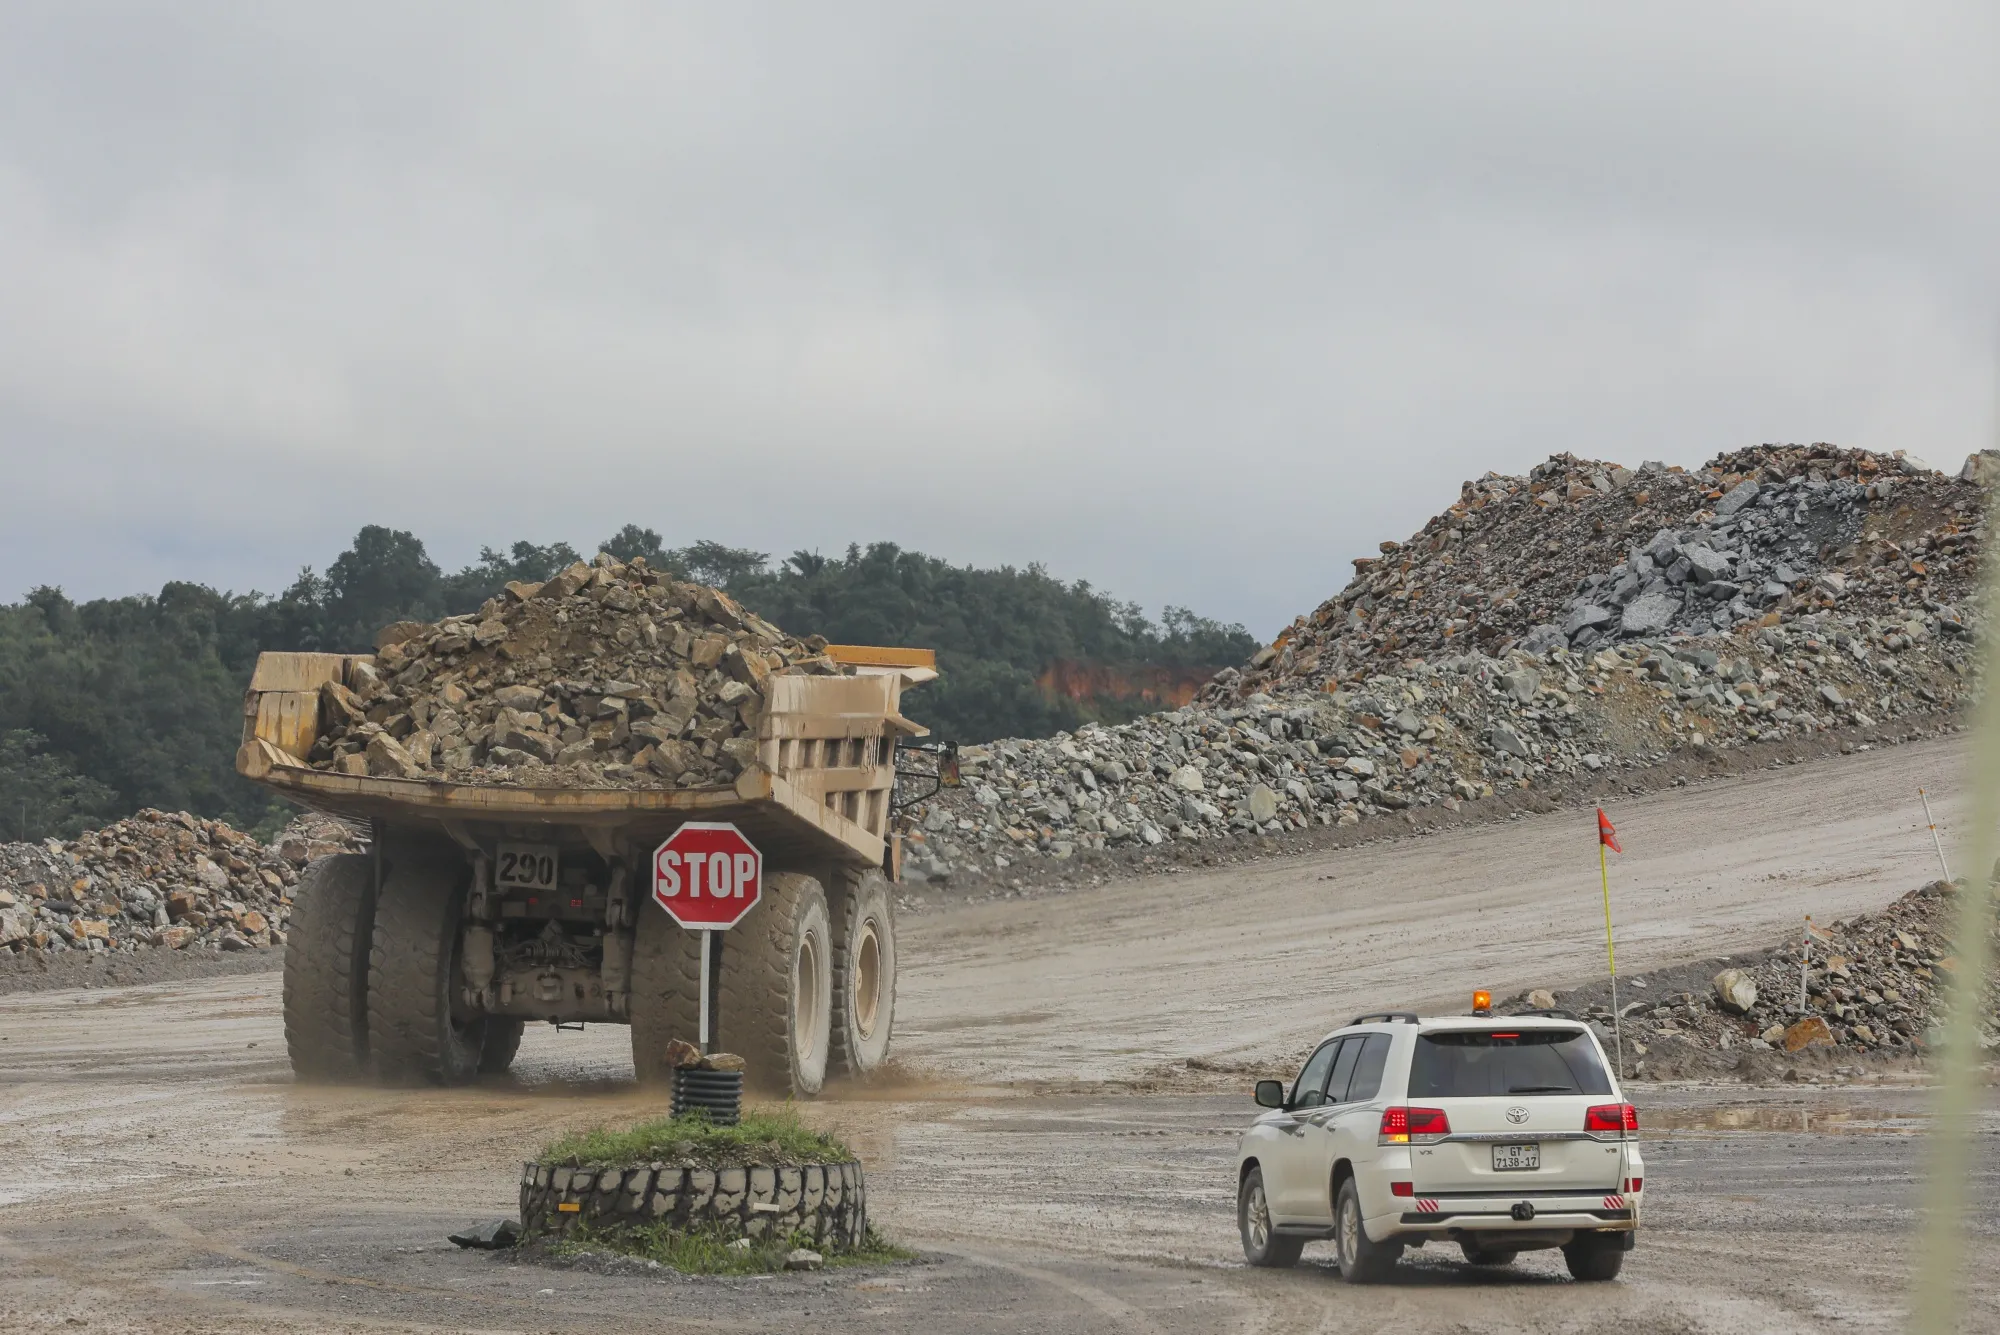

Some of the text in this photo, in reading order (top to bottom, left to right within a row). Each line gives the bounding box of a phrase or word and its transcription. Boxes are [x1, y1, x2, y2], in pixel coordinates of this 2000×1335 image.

[500, 852, 554, 885] 290
[658, 849, 756, 898] STOP
[1510, 1146, 1522, 1156] GT
[1496, 1157, 1537, 1168] 7138-17
